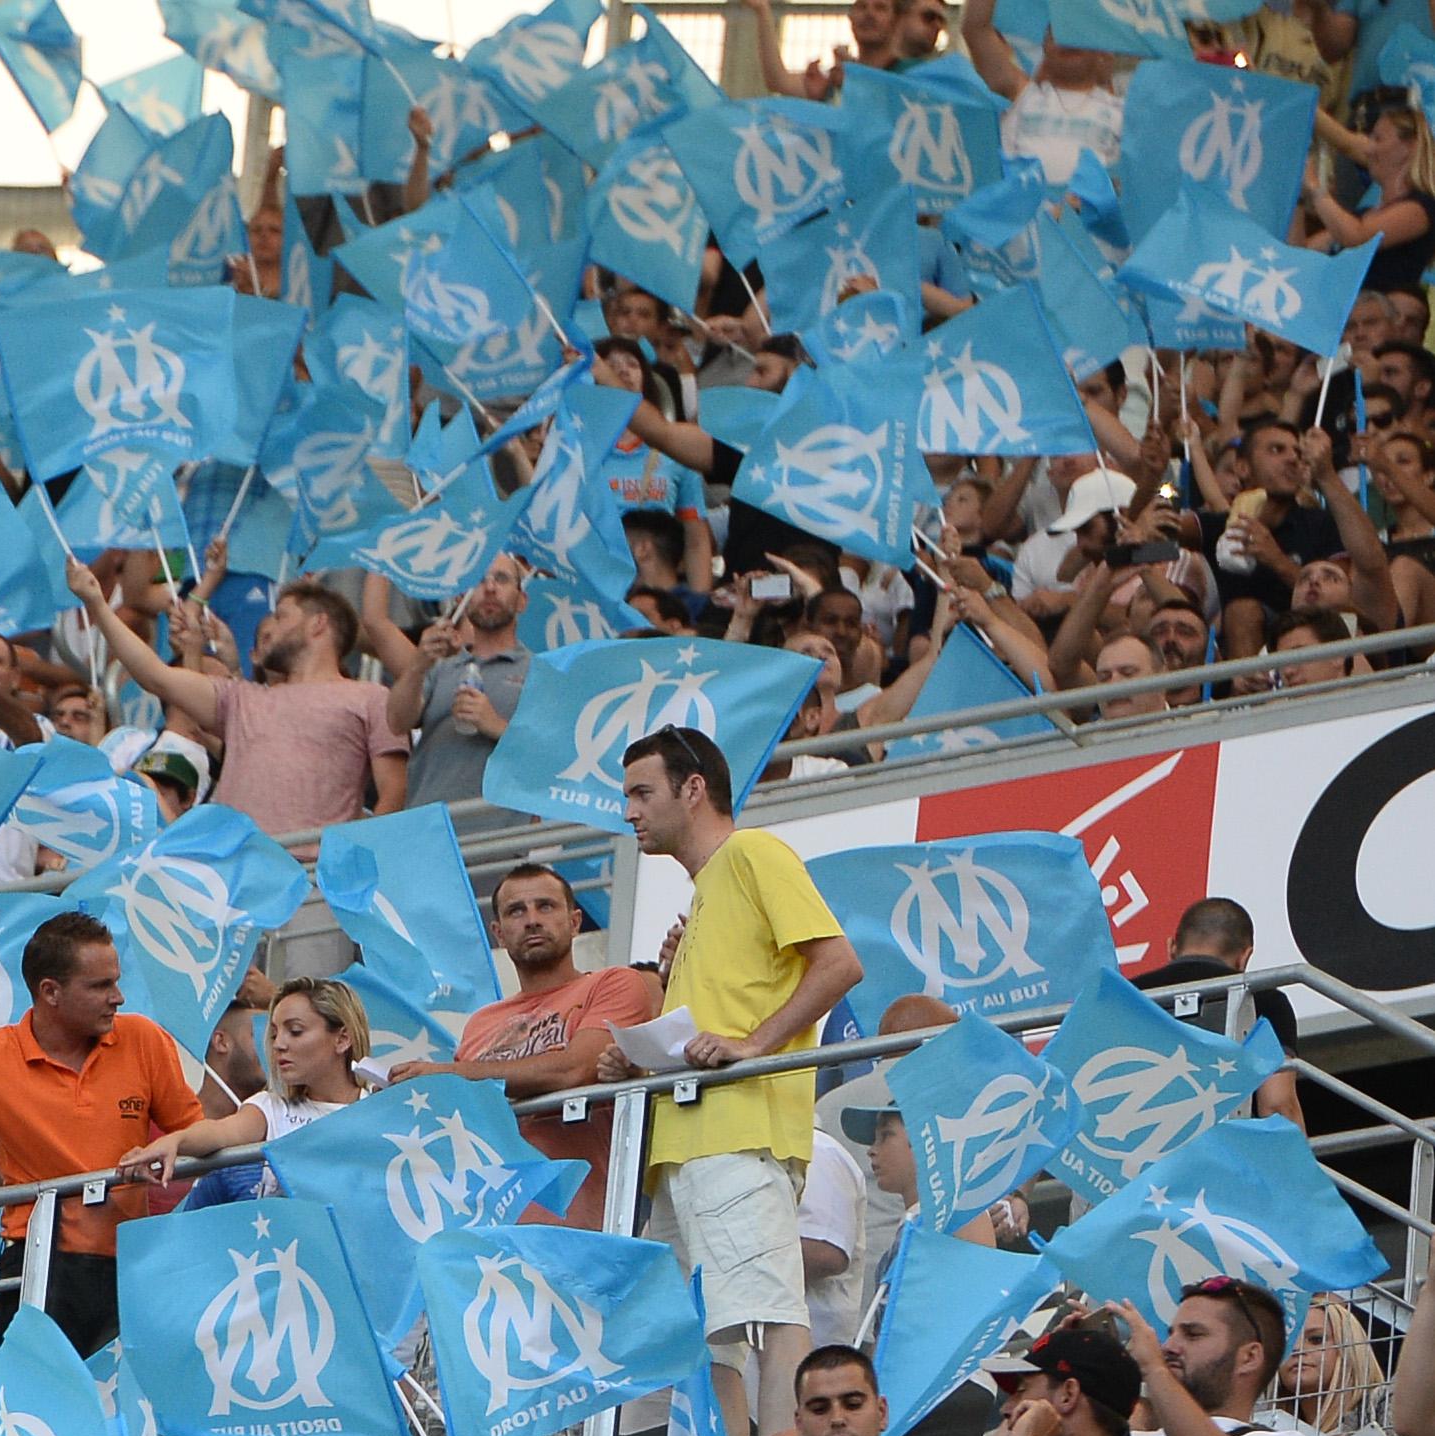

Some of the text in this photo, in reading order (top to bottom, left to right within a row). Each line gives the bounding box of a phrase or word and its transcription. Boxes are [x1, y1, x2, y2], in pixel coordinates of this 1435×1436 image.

[952, 980, 1050, 1017] OIT AU BUT
[494, 1180, 524, 1220] BUT
[556, 1388, 587, 1412] AU
